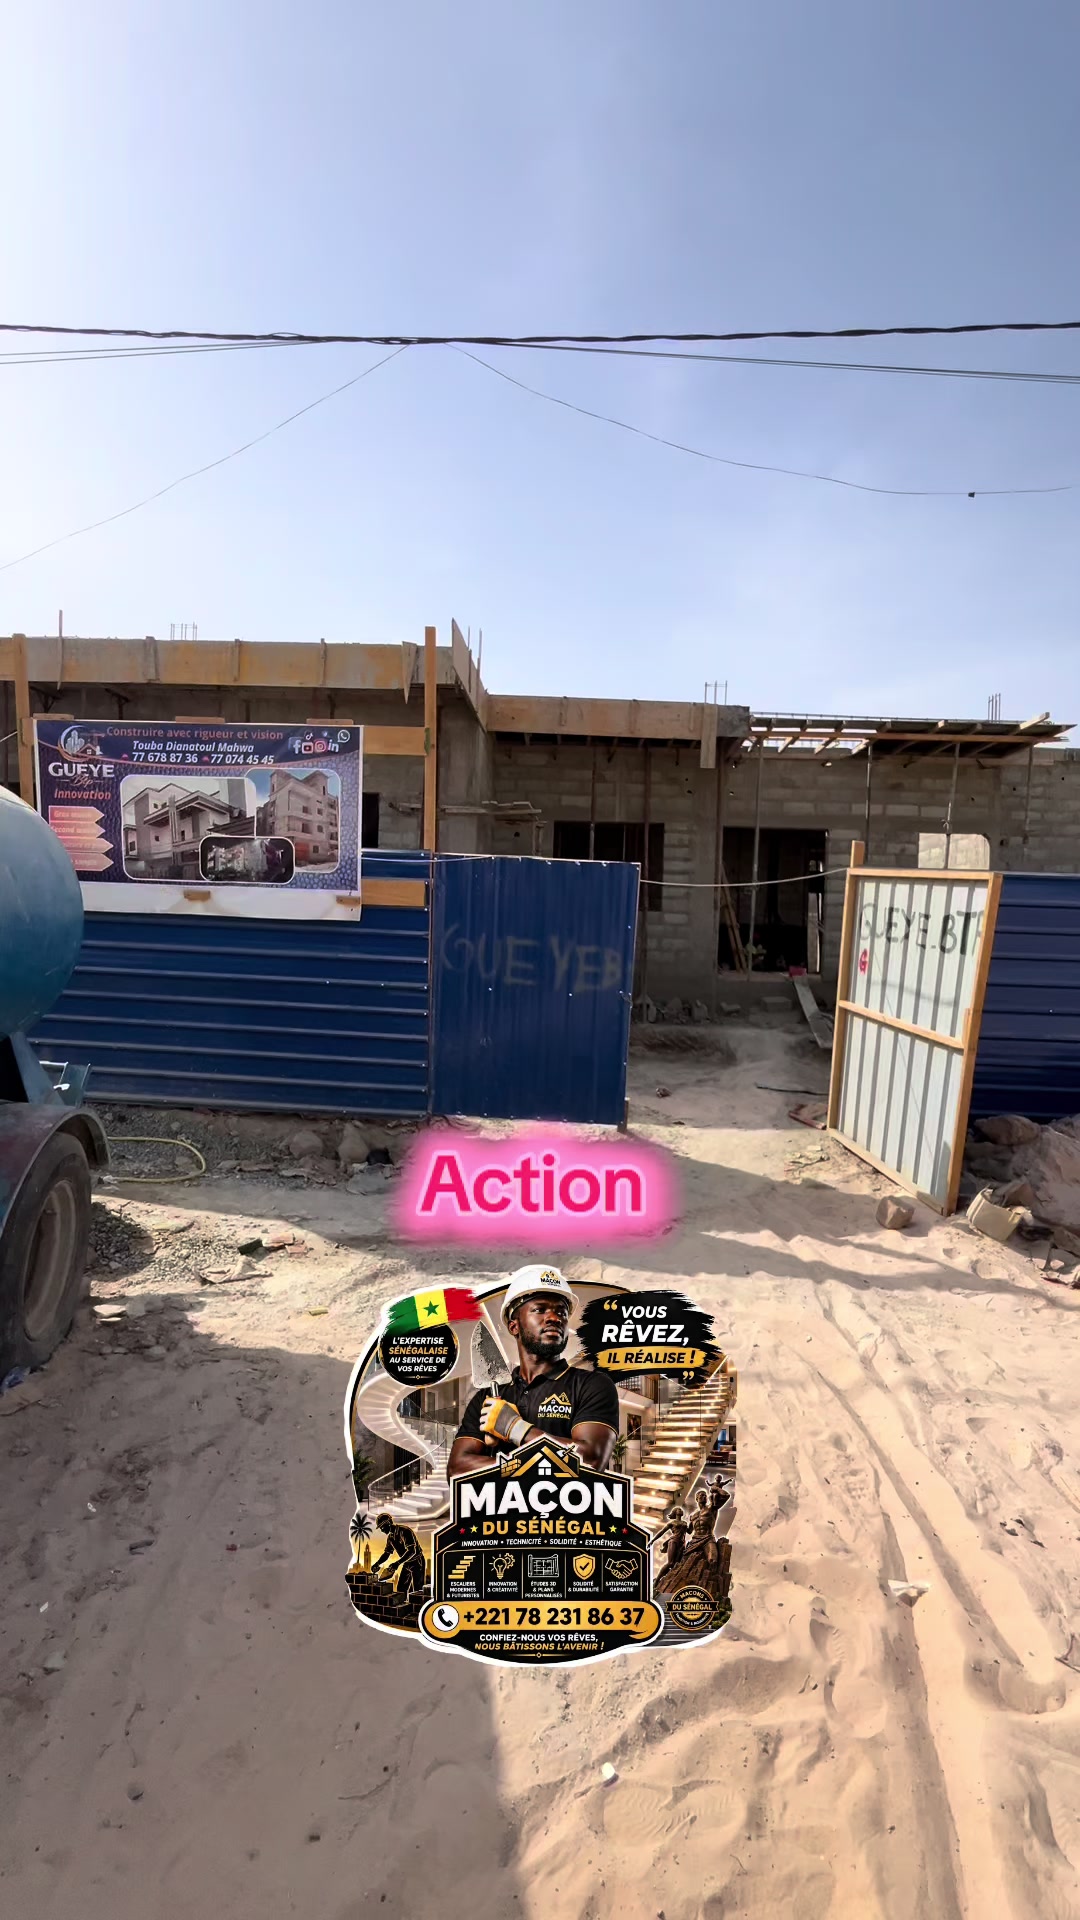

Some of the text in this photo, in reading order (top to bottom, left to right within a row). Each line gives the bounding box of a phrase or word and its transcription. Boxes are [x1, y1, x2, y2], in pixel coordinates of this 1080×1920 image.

[106, 727, 284, 741] Construire avec rigueur et vision
[133, 740, 254, 753] Touba Dianatoul Mahwa
[132, 752, 275, 765] 77 678 87 36 77 074 45 45
[48, 762, 115, 778] GUEYE
